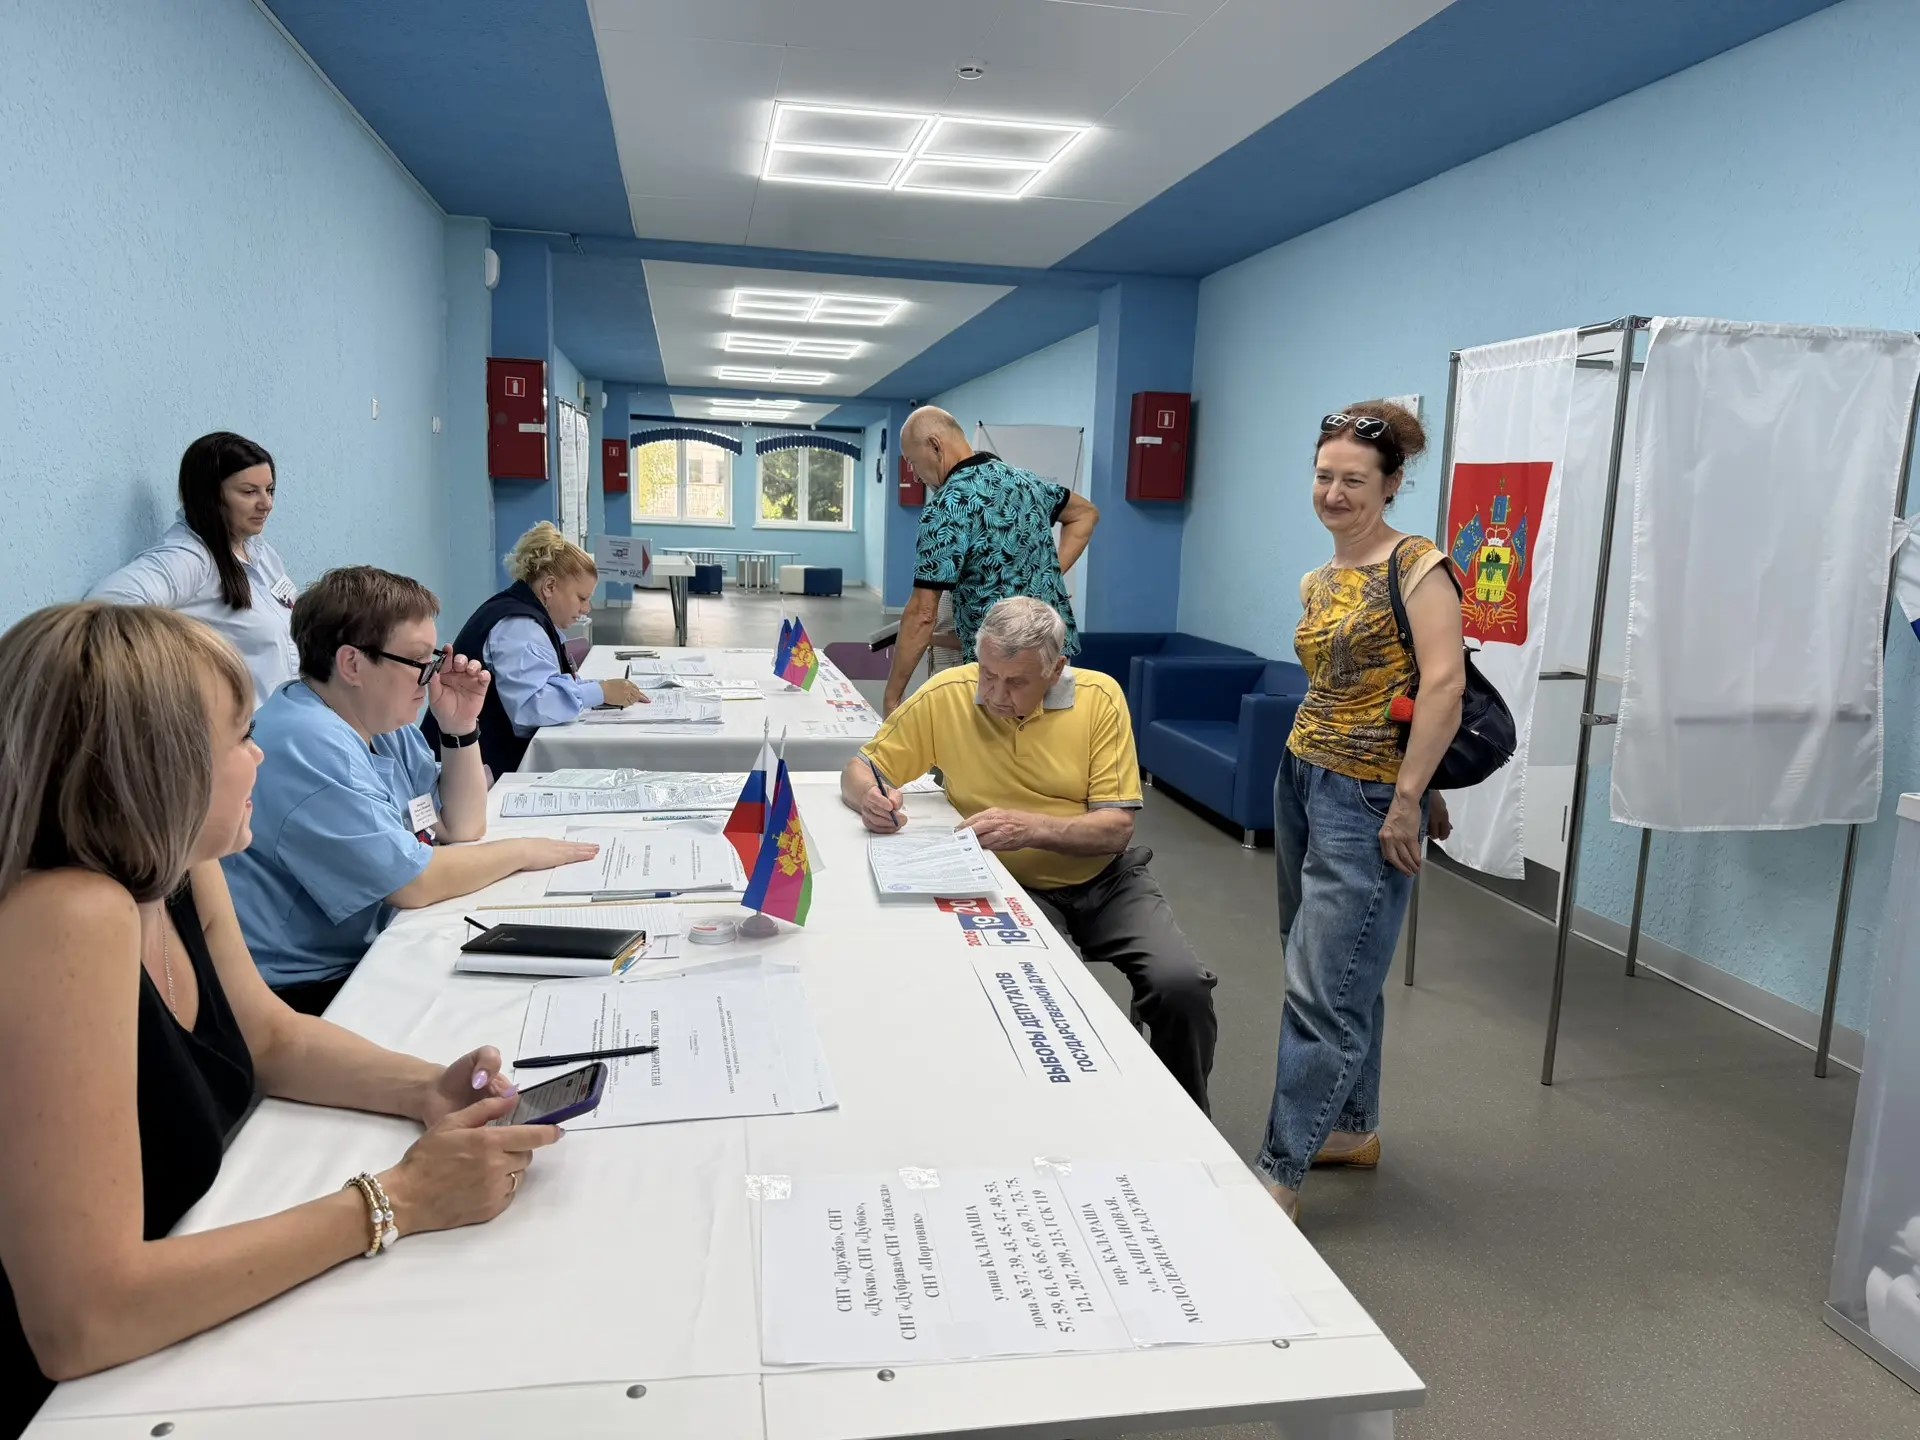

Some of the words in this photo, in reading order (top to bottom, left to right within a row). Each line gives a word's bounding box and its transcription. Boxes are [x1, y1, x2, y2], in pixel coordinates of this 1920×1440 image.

[949, 900, 981, 913] 20
[972, 916, 1004, 928] 19
[963, 931, 982, 946] 2026
[996, 930, 1030, 944] 18
[1019, 961, 1046, 984] ДУМЫ
[995, 972, 1044, 1028] ДЕПУТАТОВ
[1030, 986, 1097, 1072] ГОСУДАРСТВЕННОЙ
[1026, 1031, 1071, 1083] ВЫБОРЫ
[1032, 1190, 1048, 1203] 119
[880, 1184, 895, 1231] «Надежда»
[1016, 1205, 1031, 1218] 71,
[1039, 1207, 1058, 1226] ГСК
[828, 1208, 843, 1230] СНТ
[855, 1202, 871, 1244] «Дубок»,
[1021, 1219, 1036, 1232] 69,
[913, 1213, 933, 1271] «Портовик»
[965, 1205, 994, 1267] КАЛАРАША
[1026, 1234, 1042, 1247] 67,
[1049, 1229, 1066, 1247] 213,
[1081, 1203, 1118, 1263] КАЛАРАША
[1104, 1196, 1153, 1275] КАШТАНОВАЯ,
[1004, 1239, 1020, 1252] 43,
[832, 1232, 852, 1284] «Дружба»,
[1009, 1255, 1025, 1268] 39,
[1032, 1250, 1047, 1263] 65,
[1057, 1249, 1075, 1268] 209,
[1015, 1271, 1031, 1285] 37,
[1038, 1266, 1054, 1280] 63,
[1066, 1271, 1085, 1290] 207,
[1112, 1265, 1129, 1285] пер.
[922, 1273, 940, 1298] СНТ
[985, 1270, 1009, 1302] улица
[1019, 1288, 1036, 1299] №
[1045, 1282, 1061, 1296] 61,
[1150, 1278, 1166, 1293] ул.
[835, 1287, 852, 1312] СНТ
[1052, 1300, 1068, 1314] 59,
[1075, 1293, 1095, 1313] 121,
[1029, 1303, 1047, 1330] дома
[1057, 1317, 1075, 1332] 57,
[898, 1313, 917, 1340] СНТ
